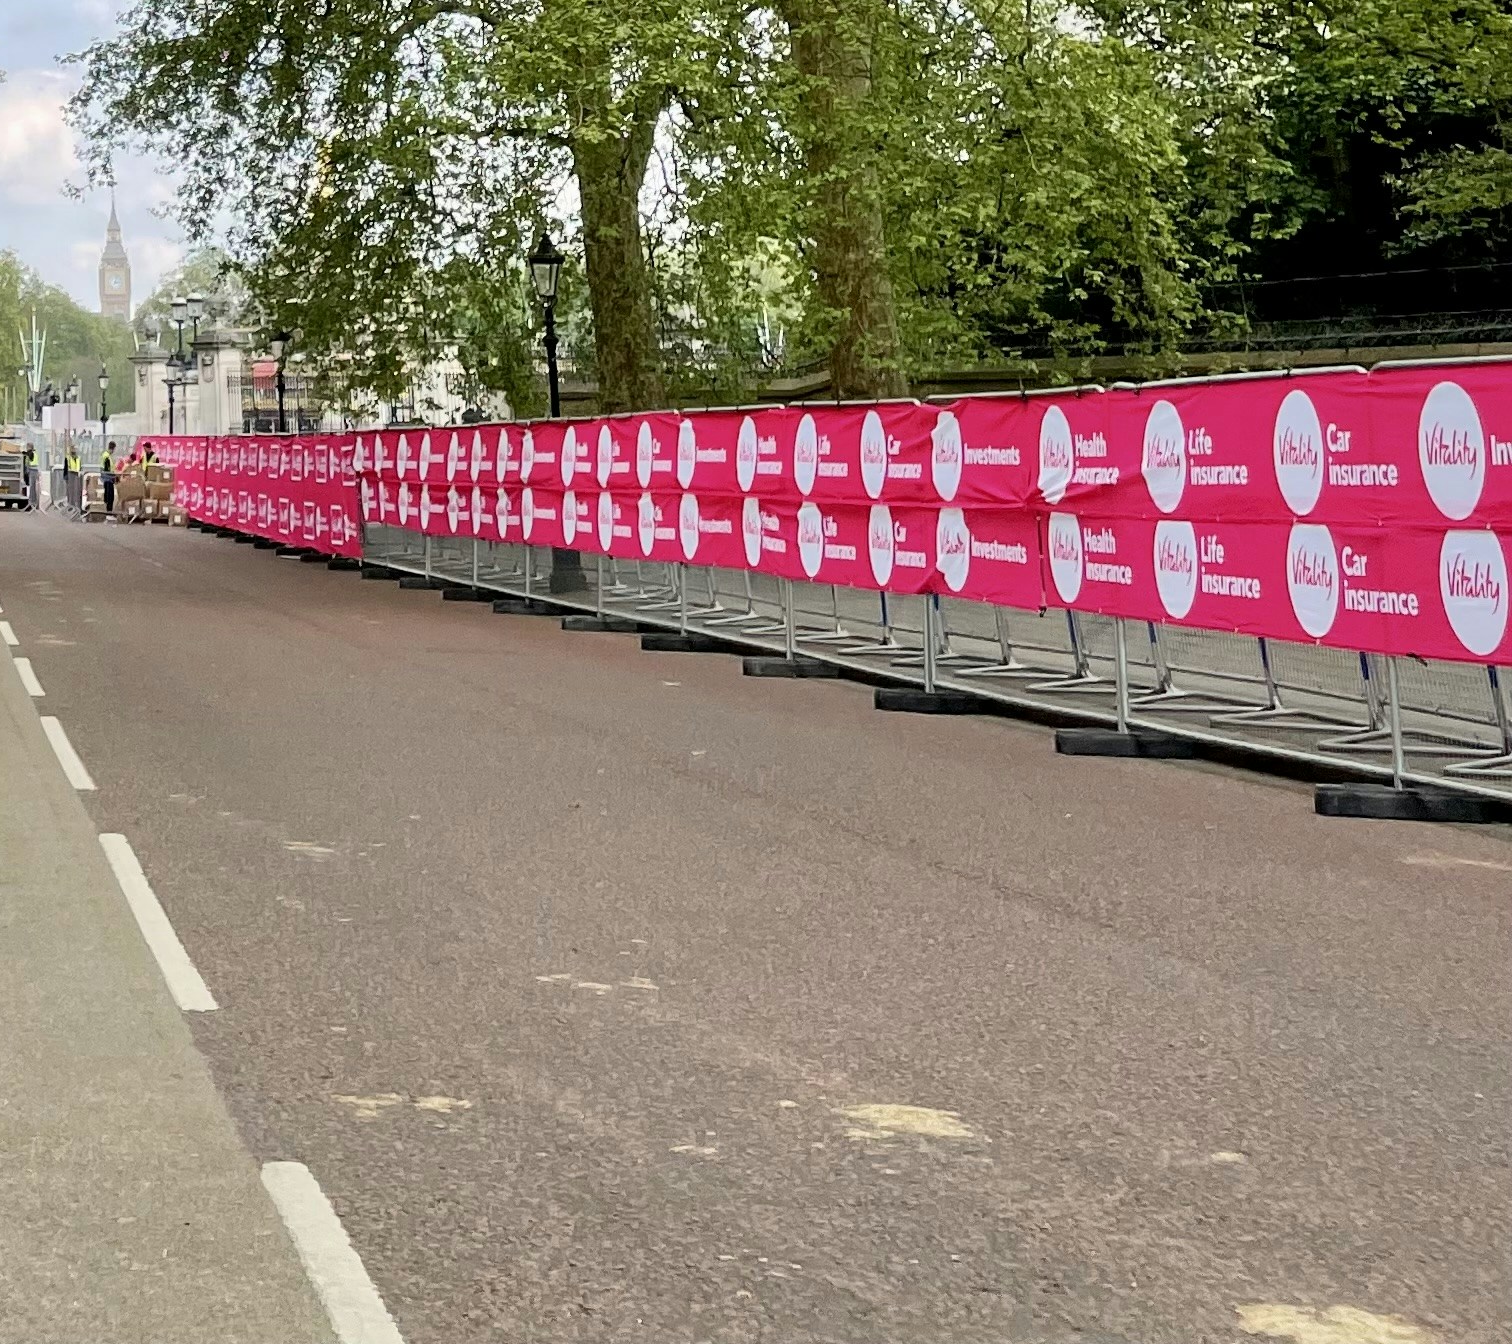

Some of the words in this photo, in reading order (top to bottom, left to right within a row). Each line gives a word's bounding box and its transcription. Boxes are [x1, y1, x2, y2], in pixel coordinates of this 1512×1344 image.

[1075, 432, 1107, 457] Health
[1188, 427, 1213, 456] Life
[1279, 426, 1319, 480] Vitality
[1326, 423, 1352, 453] Car
[1425, 422, 1477, 481] Vitality
[964, 443, 1021, 466] Investments
[1072, 460, 1120, 485] insurance
[1190, 459, 1248, 486] insurance
[1328, 457, 1398, 487] insurance
[971, 534, 1028, 565] Investments
[1083, 527, 1116, 554] Health
[1200, 535, 1225, 565] Life
[1085, 555, 1133, 586] insurance
[1158, 535, 1193, 587] Vitality
[1292, 544, 1333, 601] Vitality
[1341, 545, 1368, 577] Car
[1202, 566, 1261, 600] insurance
[1344, 579, 1419, 617] insurance
[1447, 553, 1501, 616] Vitality
